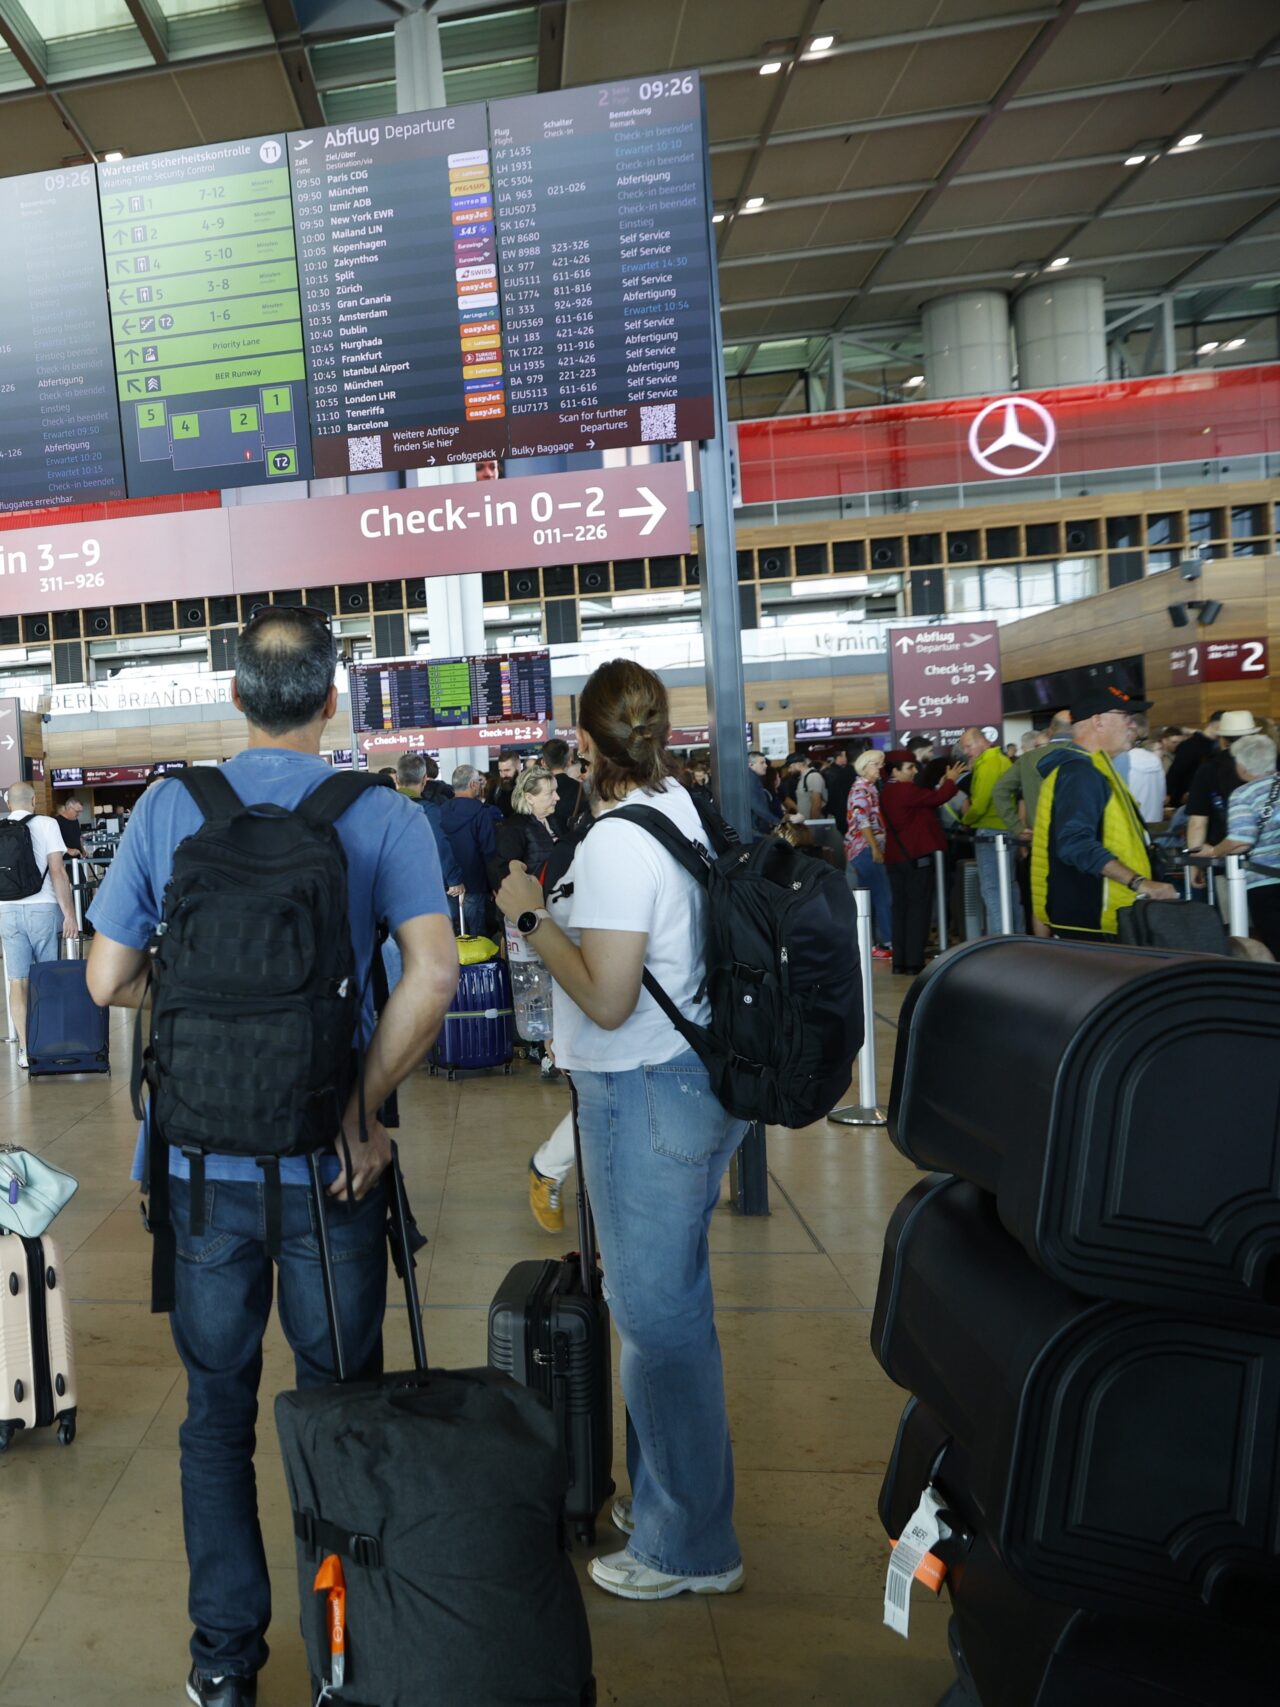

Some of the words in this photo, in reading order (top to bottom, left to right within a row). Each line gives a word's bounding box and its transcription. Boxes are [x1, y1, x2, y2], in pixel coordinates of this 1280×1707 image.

[639, 76, 693, 100] 09:26
[324, 126, 379, 148] Abflug
[385, 118, 455, 139] Departure
[262, 144, 278, 159] T1
[102, 161, 148, 176] Wartezeit
[151, 144, 250, 168] Sicherheitskontrolle
[44, 170, 90, 191] 09:26
[103, 178, 131, 188] Waiting
[133, 174, 152, 182] Time
[154, 169, 184, 180] Security
[186, 162, 215, 175] Control
[327, 172, 348, 183] Paris
[350, 169, 368, 180] CDG
[148, 198, 152, 209] 1
[199, 186, 224, 200] 7-12
[328, 185, 368, 197] München
[329, 200, 351, 211] Izmir
[353, 197, 371, 208] ADB
[330, 216, 349, 225] New
[351, 211, 371, 222] York
[373, 208, 393, 219] EWR
[150, 228, 157, 240] 2
[202, 217, 224, 230] 4-9
[332, 239, 386, 253] Kopenhagen
[153, 259, 160, 269] 4
[204, 247, 232, 262] 5-10
[334, 254, 378, 267] Zakynthos
[156, 288, 163, 300] 5
[207, 278, 229, 292] 3-8
[336, 283, 362, 294] Zürich
[337, 299, 357, 308] Gran
[359, 293, 391, 305] Canaria
[159, 317, 173, 330] T2
[210, 308, 230, 322] 1-6
[212, 341, 240, 350] Priority
[215, 372, 229, 380] BER
[231, 369, 261, 377] Runway
[342, 364, 377, 377] Istanbul
[379, 361, 409, 373] Airport
[273, 393, 278, 405] 1
[344, 393, 376, 404] London
[378, 390, 396, 400] LHR
[147, 408, 155, 421] 5
[345, 405, 384, 417] Teneriffa
[558, 414, 579, 422] Scan
[581, 411, 594, 420] for
[596, 408, 627, 418] further
[181, 420, 190, 431] 4
[240, 413, 247, 425] 2
[347, 420, 388, 431] Barcelona
[392, 430, 424, 440] Weitere
[426, 426, 459, 436] Abflüge
[580, 421, 628, 433] Departures
[393, 442, 420, 452] finden
[422, 440, 434, 449] Sie
[436, 438, 453, 447] hier
[511, 445, 535, 455] Bulky
[537, 442, 574, 454] Baggage
[274, 456, 287, 466] T2
[446, 449, 496, 462] Großgepäck
[500, 447, 504, 457] /
[34, 495, 72, 505] erreichbar.
[360, 494, 517, 538] Check-in
[531, 487, 605, 523] 0–2
[533, 524, 608, 546] 011–226
[38, 538, 100, 570] 3–9
[40, 572, 104, 593] 311–926
[916, 632, 954, 643] Abflug
[916, 642, 960, 652] Departure
[1241, 642, 1265, 672] 2
[924, 663, 975, 676] Check-in
[918, 694, 968, 707] Check-in
[374, 736, 407, 745] Check-in
[479, 729, 513, 739] Check-in
